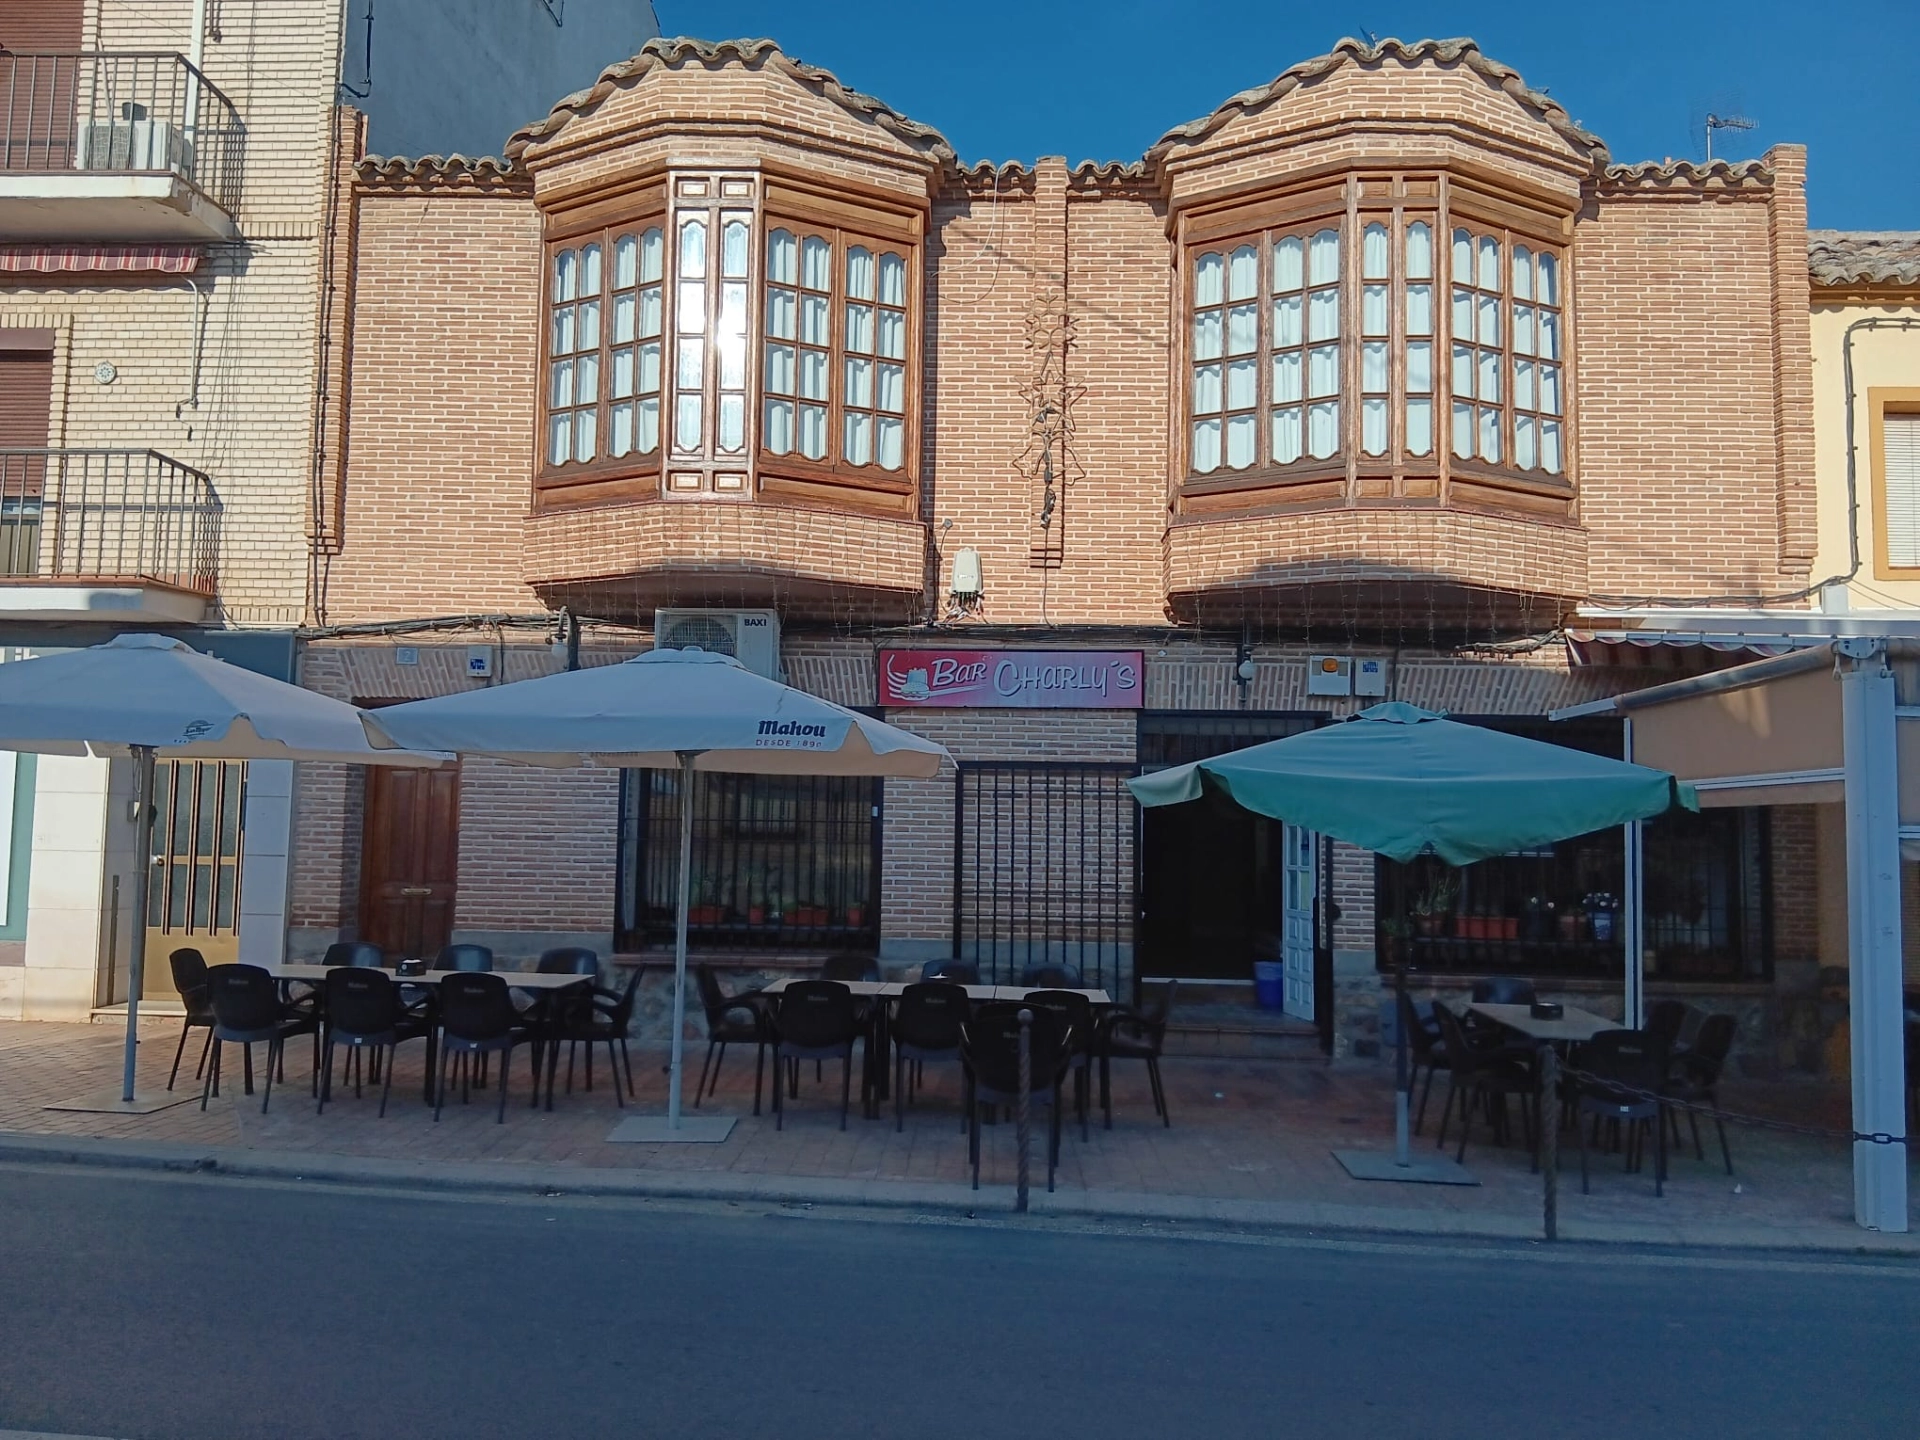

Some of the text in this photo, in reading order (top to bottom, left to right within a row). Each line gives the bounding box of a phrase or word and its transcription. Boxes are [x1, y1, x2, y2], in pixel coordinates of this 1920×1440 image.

[744, 618, 767, 627] BAXI
[758, 720, 826, 737] Mahou
[755, 739, 791, 747] DESDE
